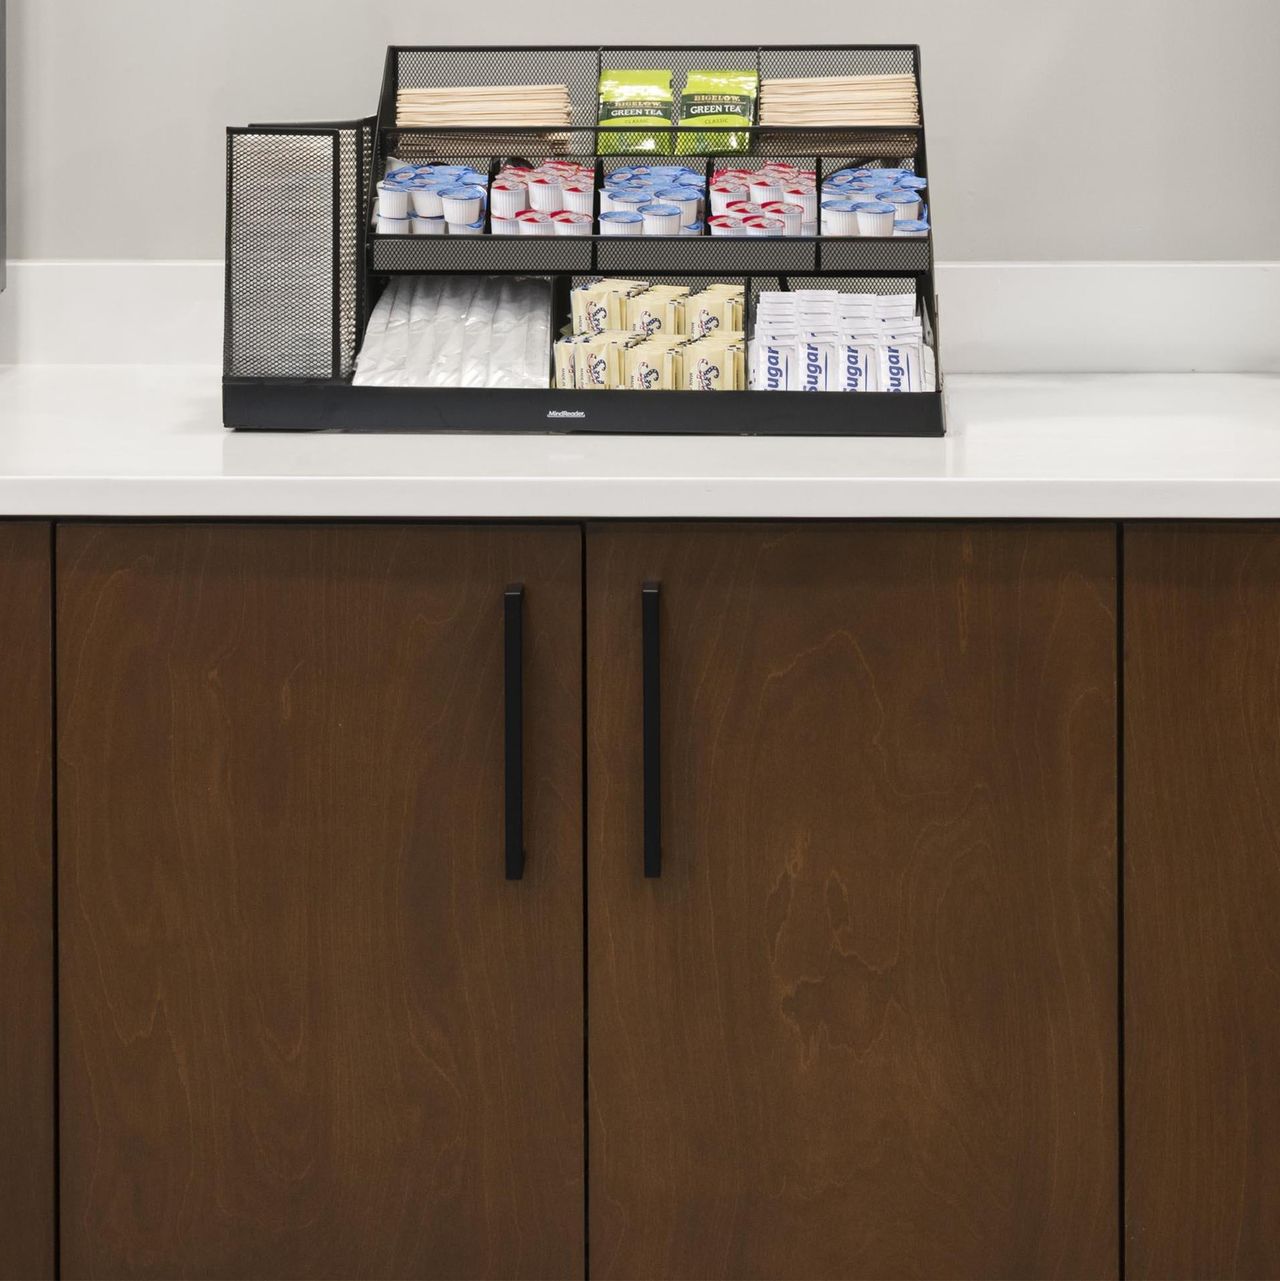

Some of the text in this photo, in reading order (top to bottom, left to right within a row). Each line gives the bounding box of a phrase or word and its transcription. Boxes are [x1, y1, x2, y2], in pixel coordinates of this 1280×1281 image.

[690, 104, 742, 114] GREEN TEA
[764, 346, 783, 391] ugar
